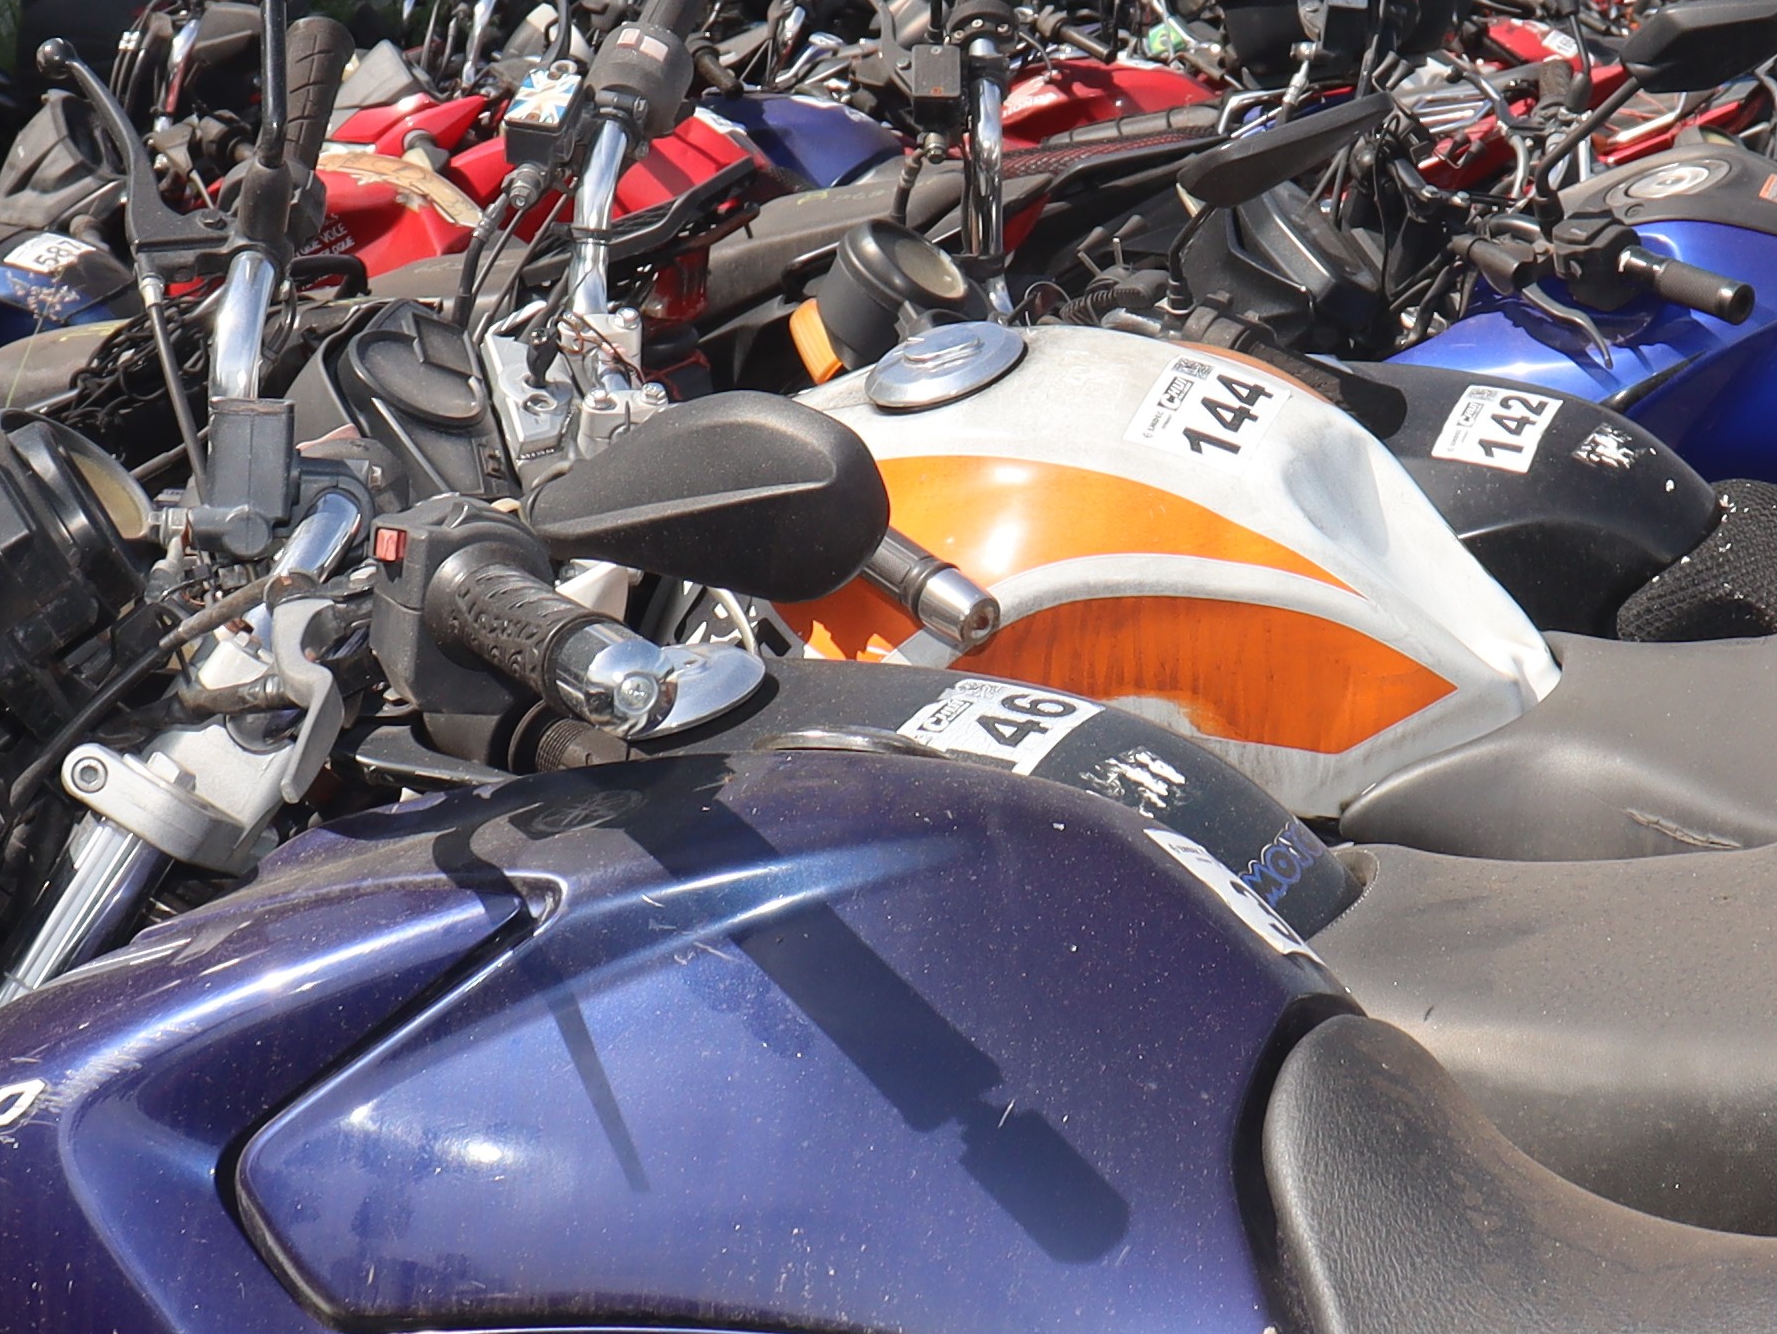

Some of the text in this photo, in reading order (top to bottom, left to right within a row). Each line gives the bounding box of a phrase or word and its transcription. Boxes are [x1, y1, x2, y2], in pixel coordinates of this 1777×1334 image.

[1182, 373, 1275, 456] 144
[1477, 395, 1550, 459] 142
[976, 694, 1077, 748] 46
